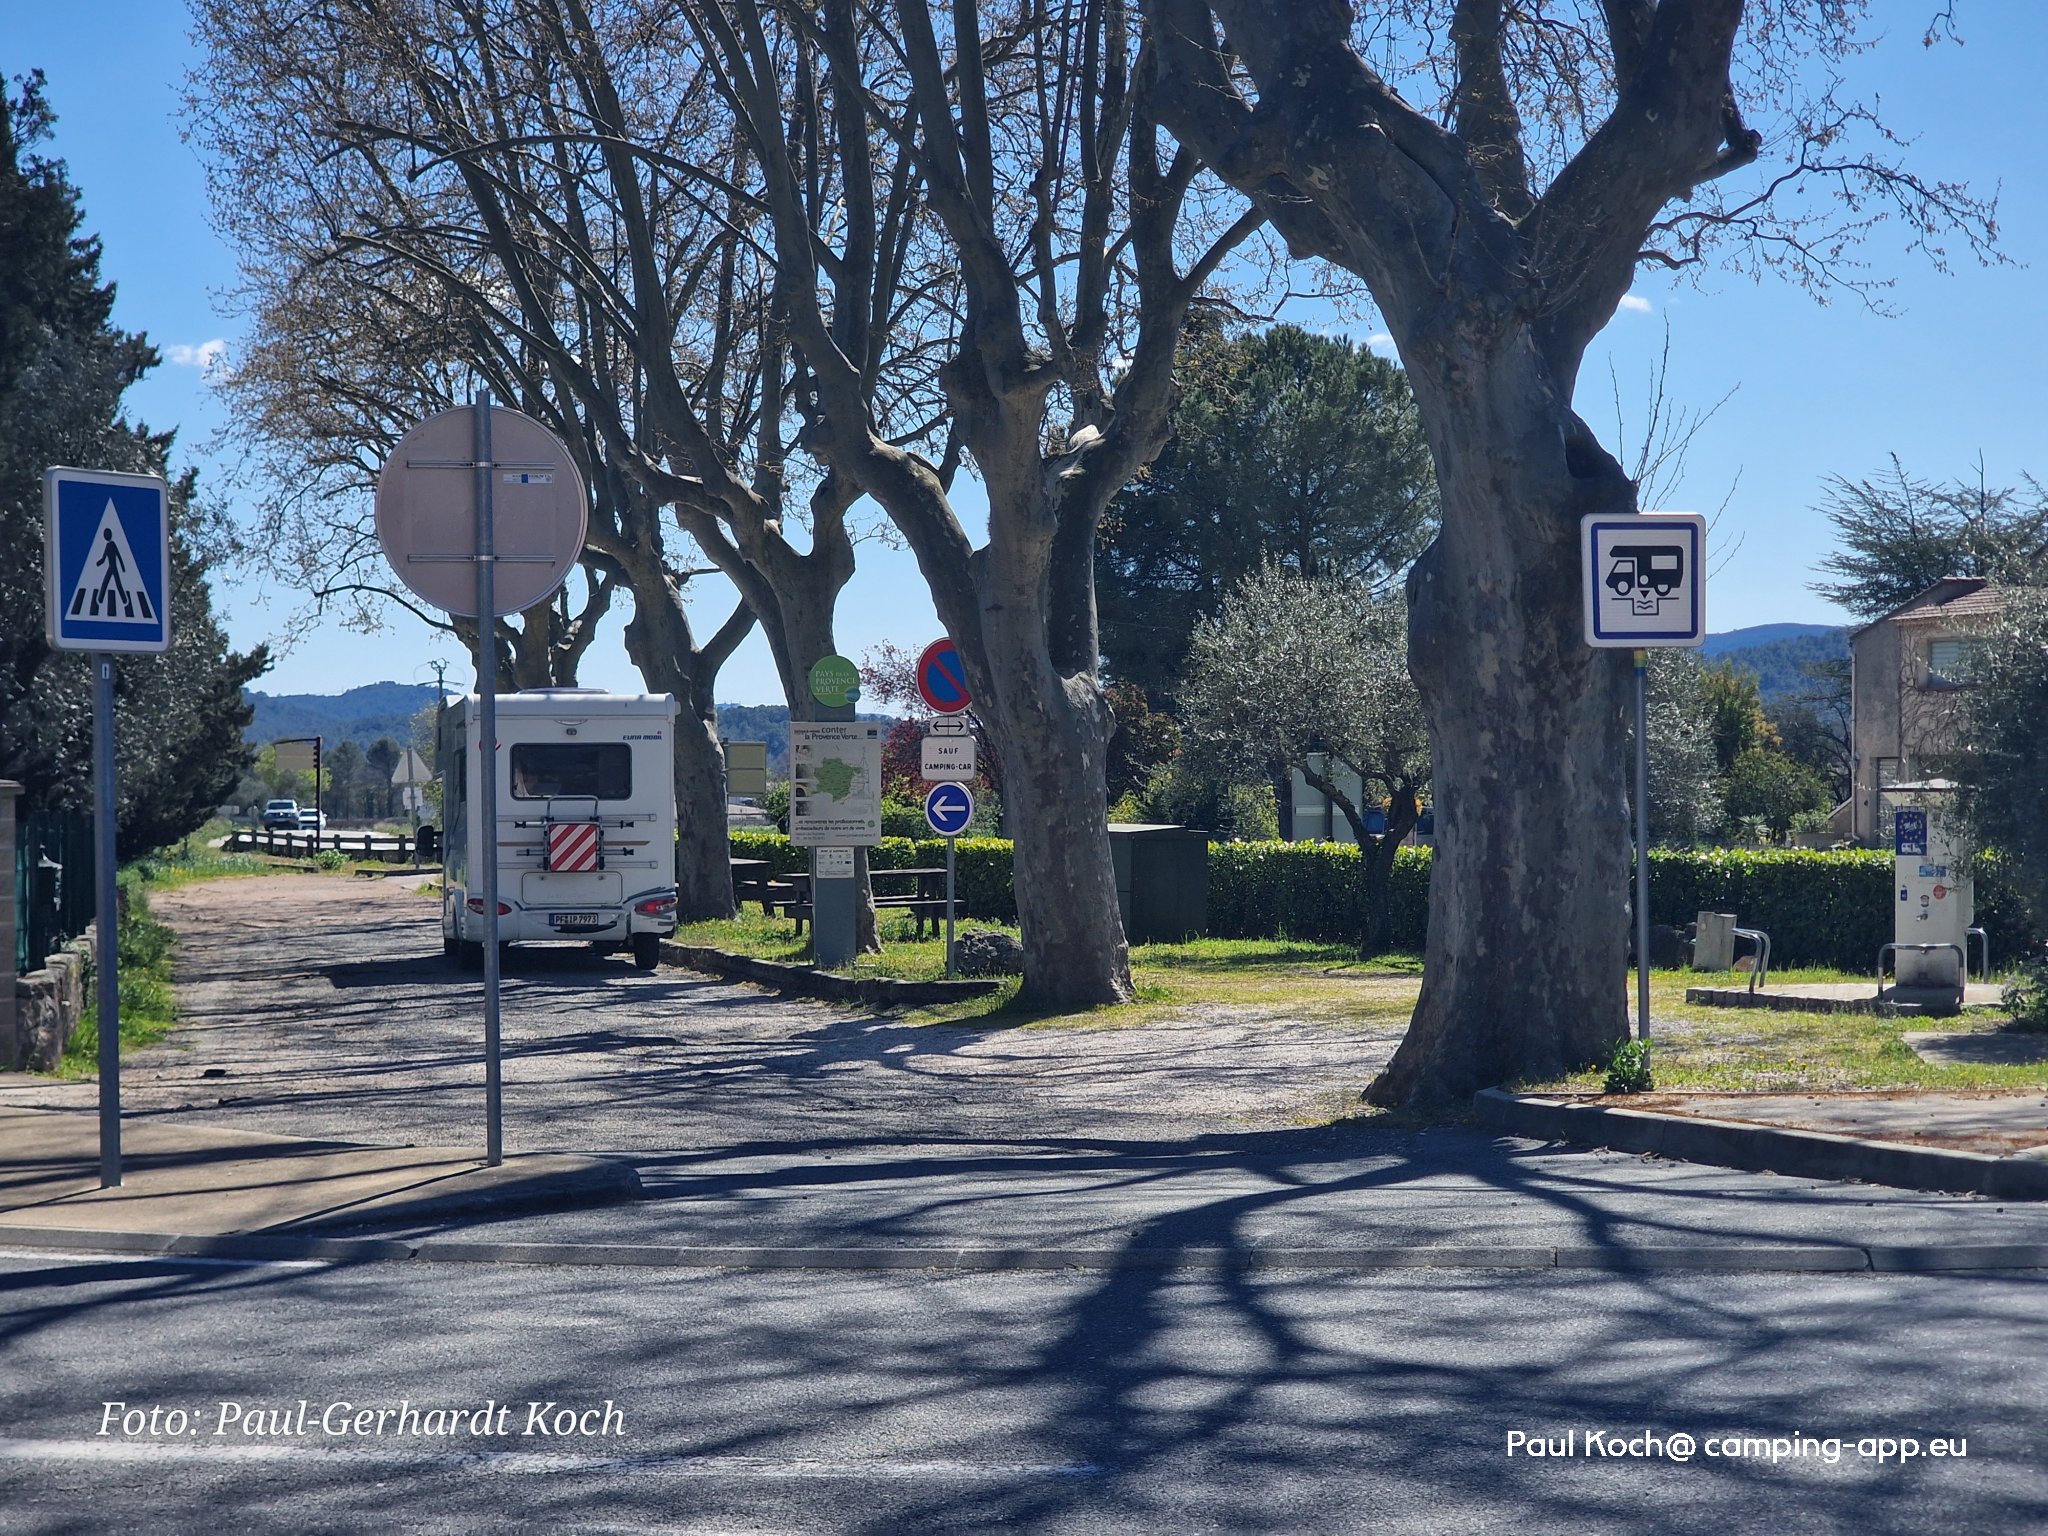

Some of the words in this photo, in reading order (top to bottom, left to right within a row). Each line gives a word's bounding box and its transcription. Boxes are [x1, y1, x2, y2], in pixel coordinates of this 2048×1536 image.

[815, 677, 857, 685] PROVENCE
[815, 685, 840, 693] VERTE
[821, 726, 847, 734] conter
[938, 747, 959, 755] SAUF
[579, 915, 596, 923] 7973
